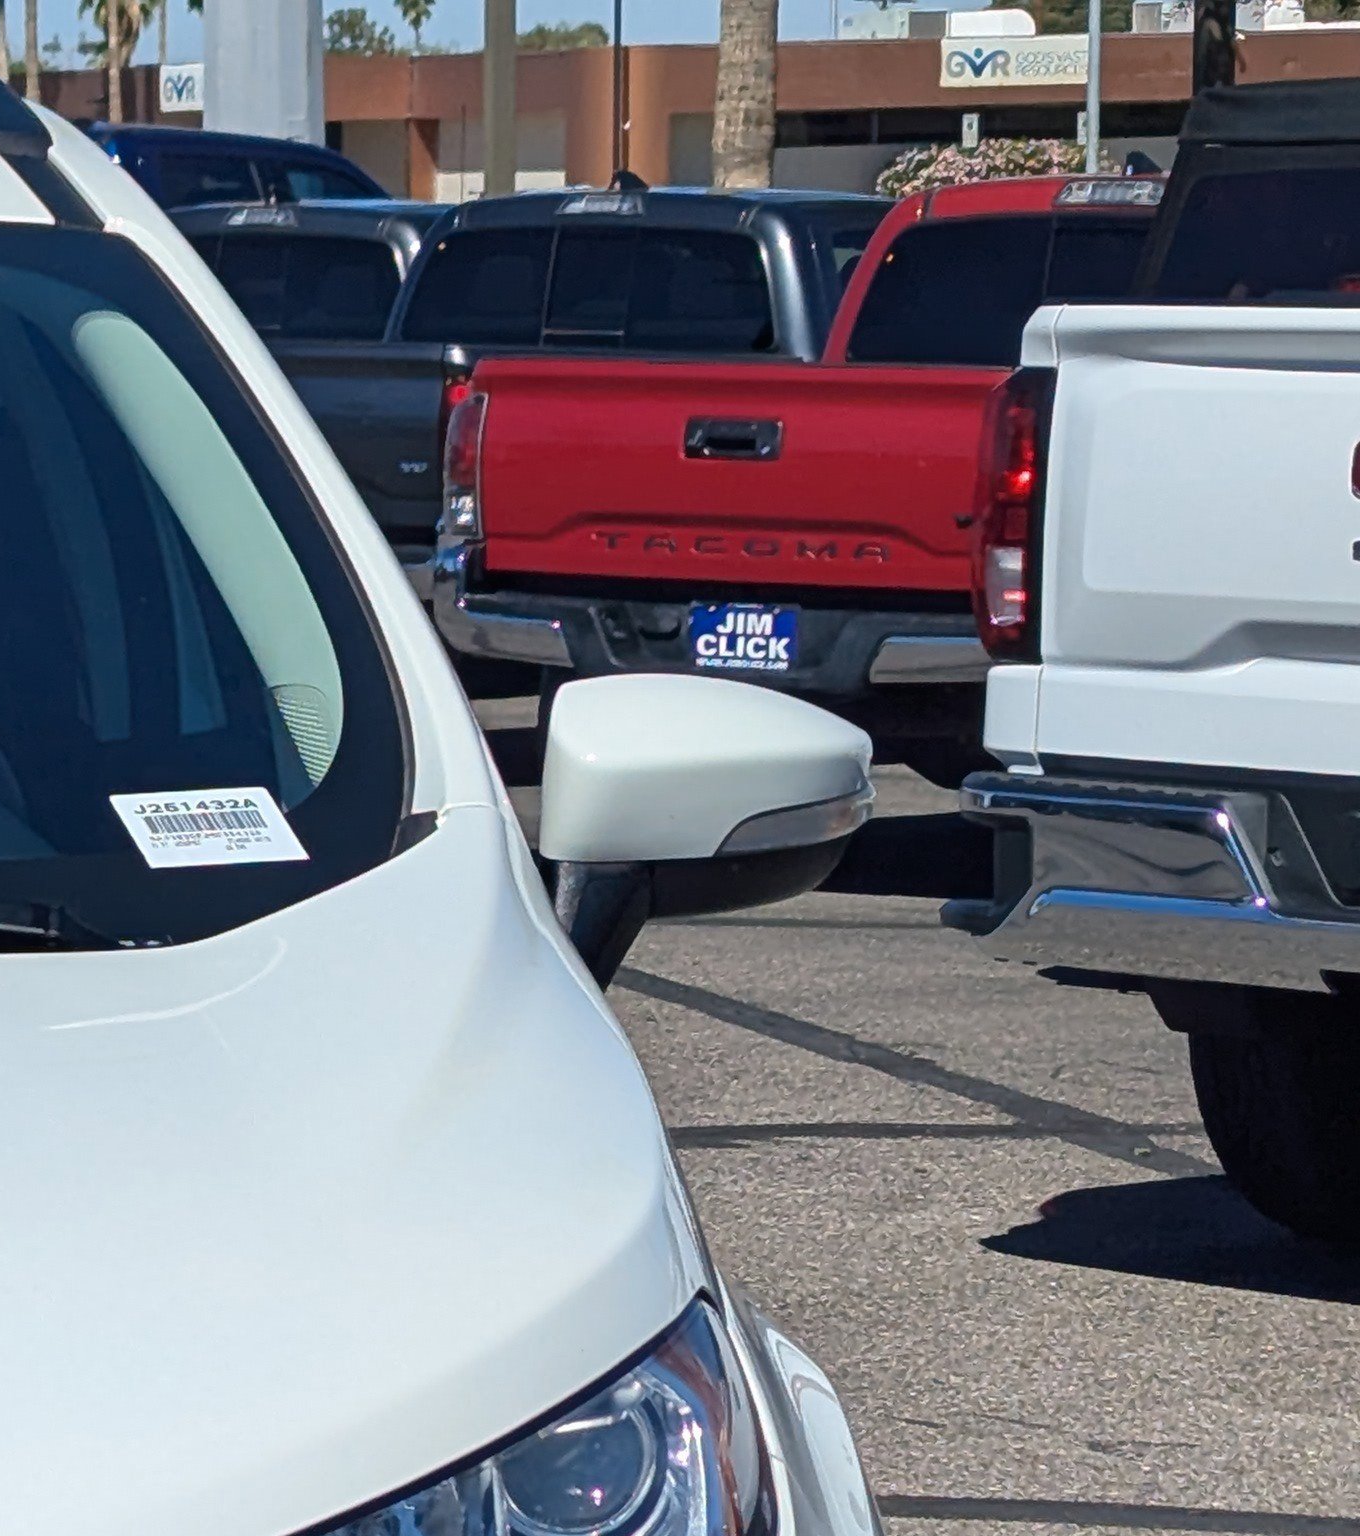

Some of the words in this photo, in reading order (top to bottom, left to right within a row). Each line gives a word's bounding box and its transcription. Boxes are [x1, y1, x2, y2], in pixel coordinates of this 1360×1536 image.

[590, 530, 889, 563] TACOMA
[715, 611, 774, 636] JIM
[695, 633, 791, 661] CLICK
